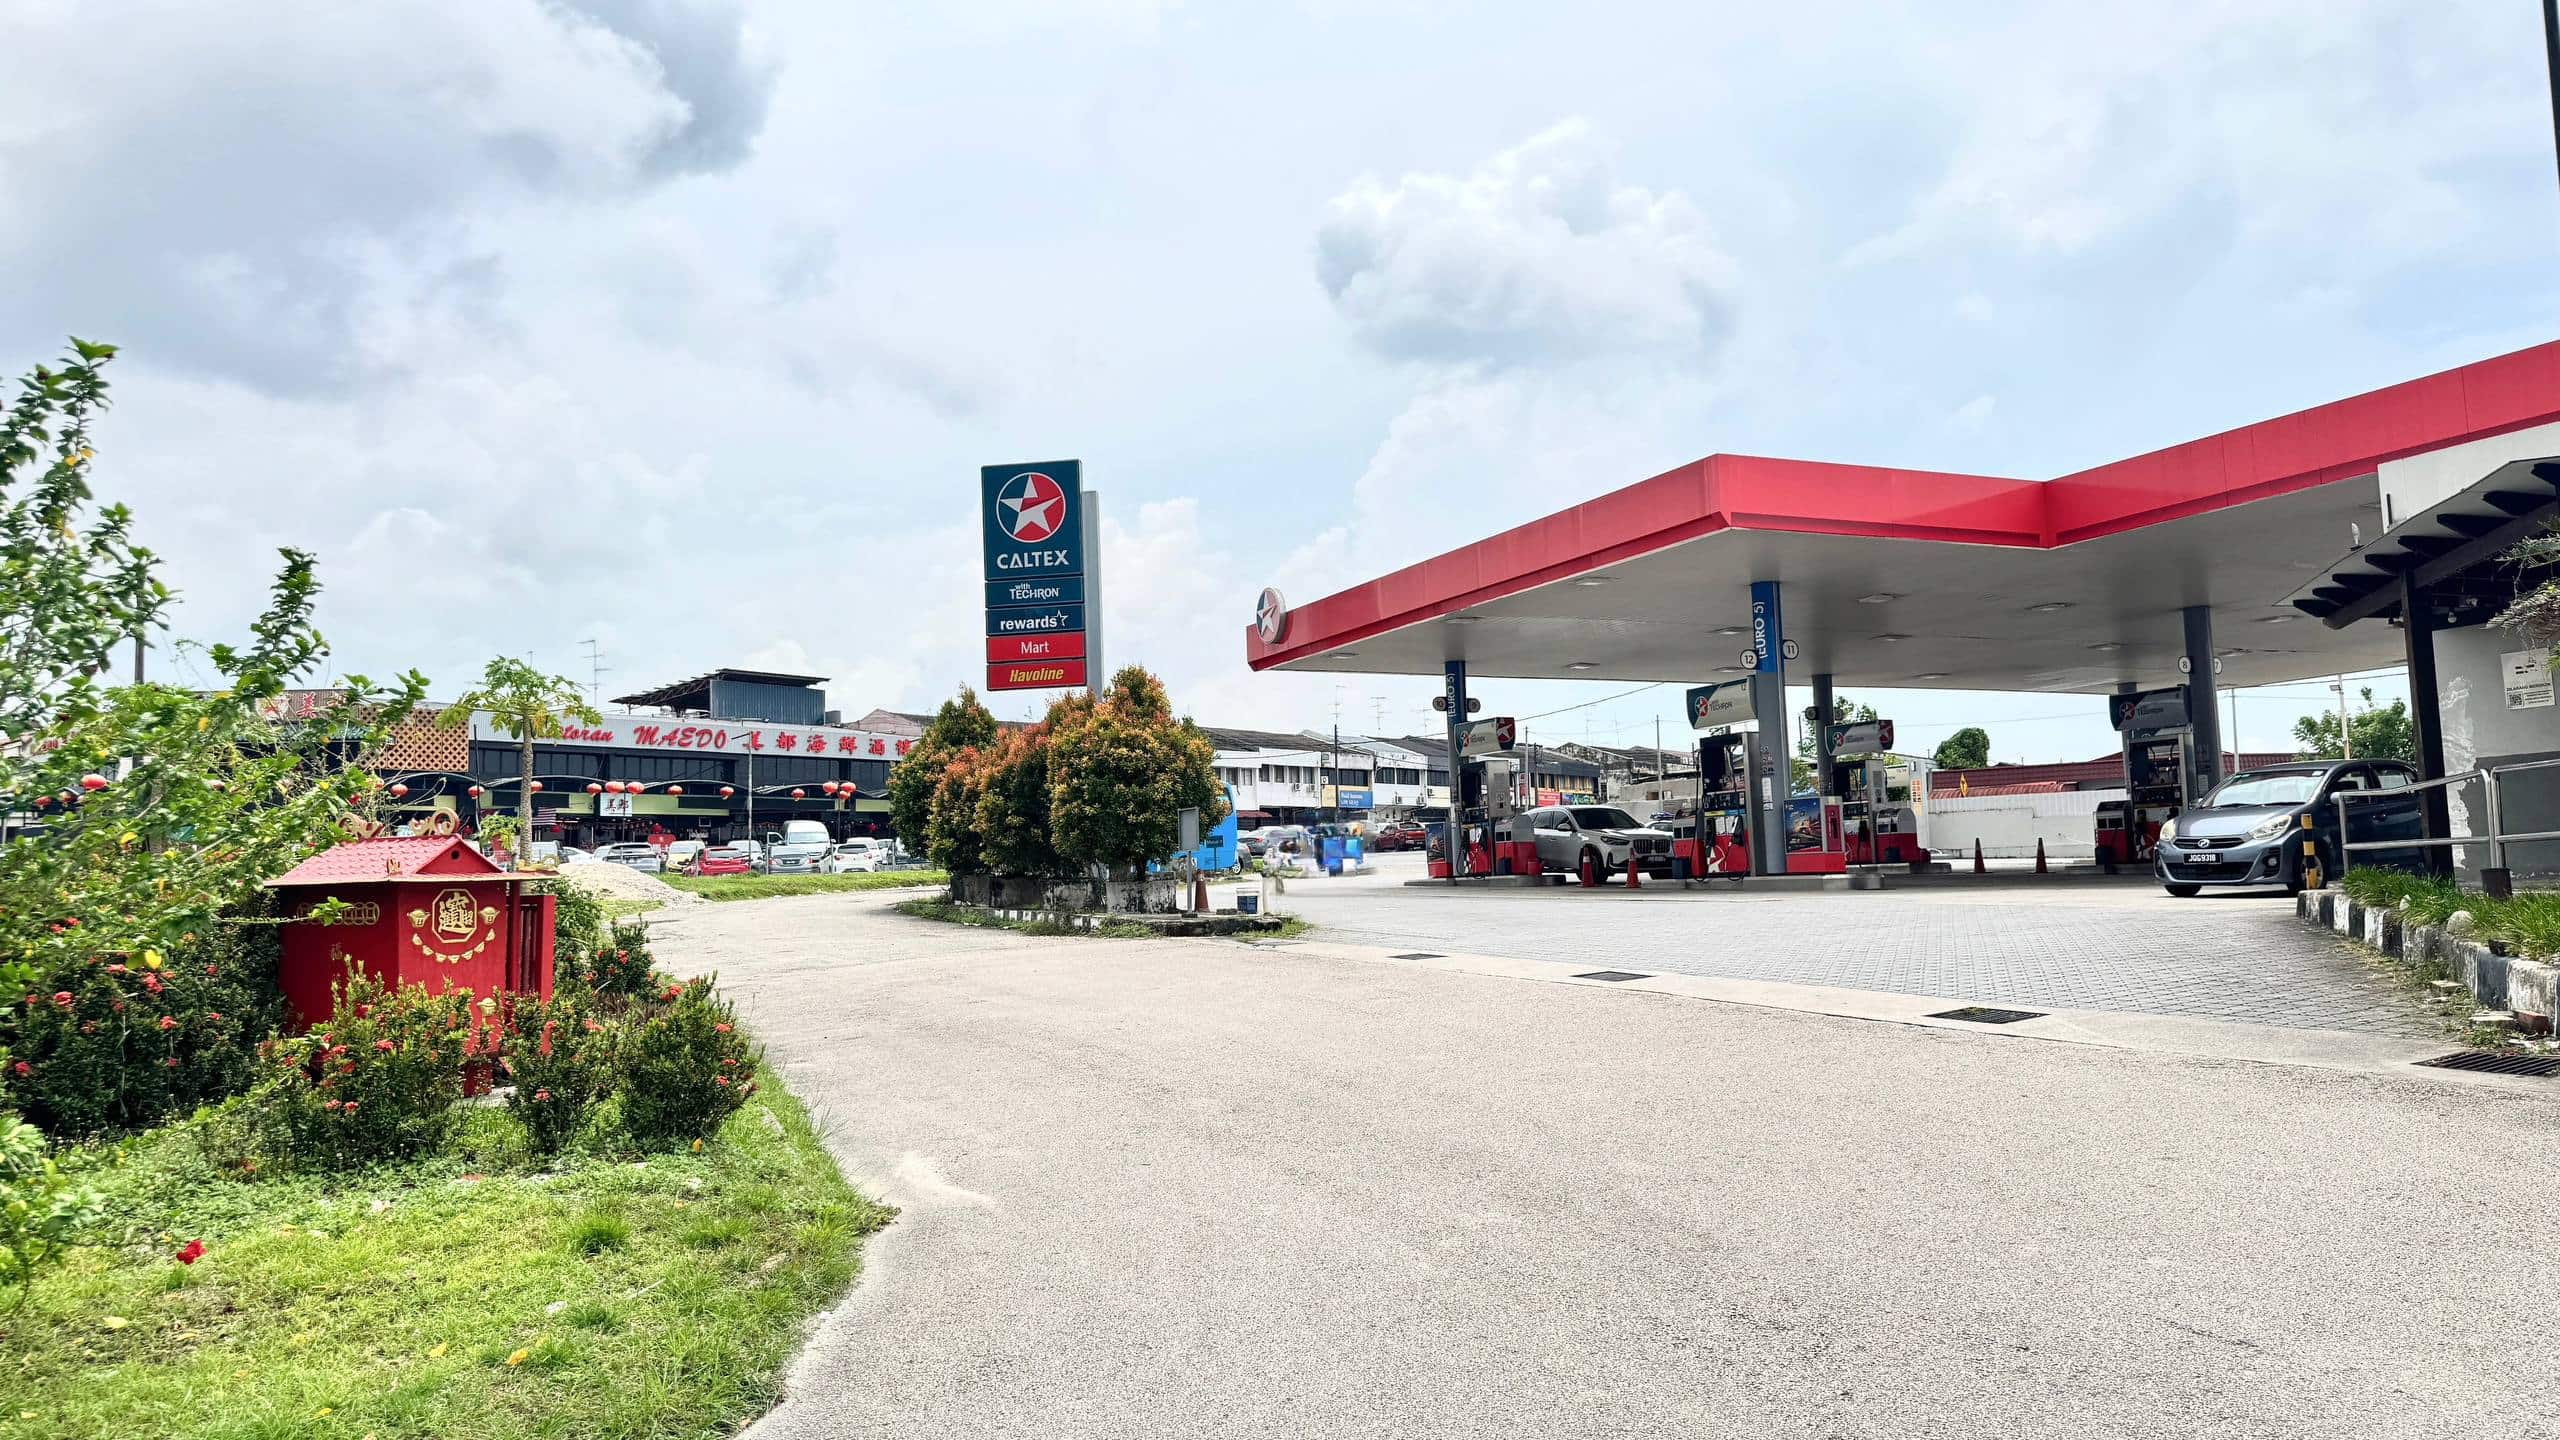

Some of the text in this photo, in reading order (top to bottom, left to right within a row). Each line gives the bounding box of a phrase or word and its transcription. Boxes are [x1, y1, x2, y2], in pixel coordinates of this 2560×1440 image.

[997, 549, 1069, 570] CALTEX
[1009, 587, 1060, 600] TECHRON
[1000, 615, 1057, 630] rewards
[1753, 601, 1768, 659] (EURO 5)
[1021, 641, 1050, 654] Mart
[1787, 645, 1795, 655] 11
[1744, 654, 1754, 665] 12
[2182, 660, 2188, 669] 8
[1010, 667, 1064, 682] Havoline
[634, 725, 728, 749] MAEDO
